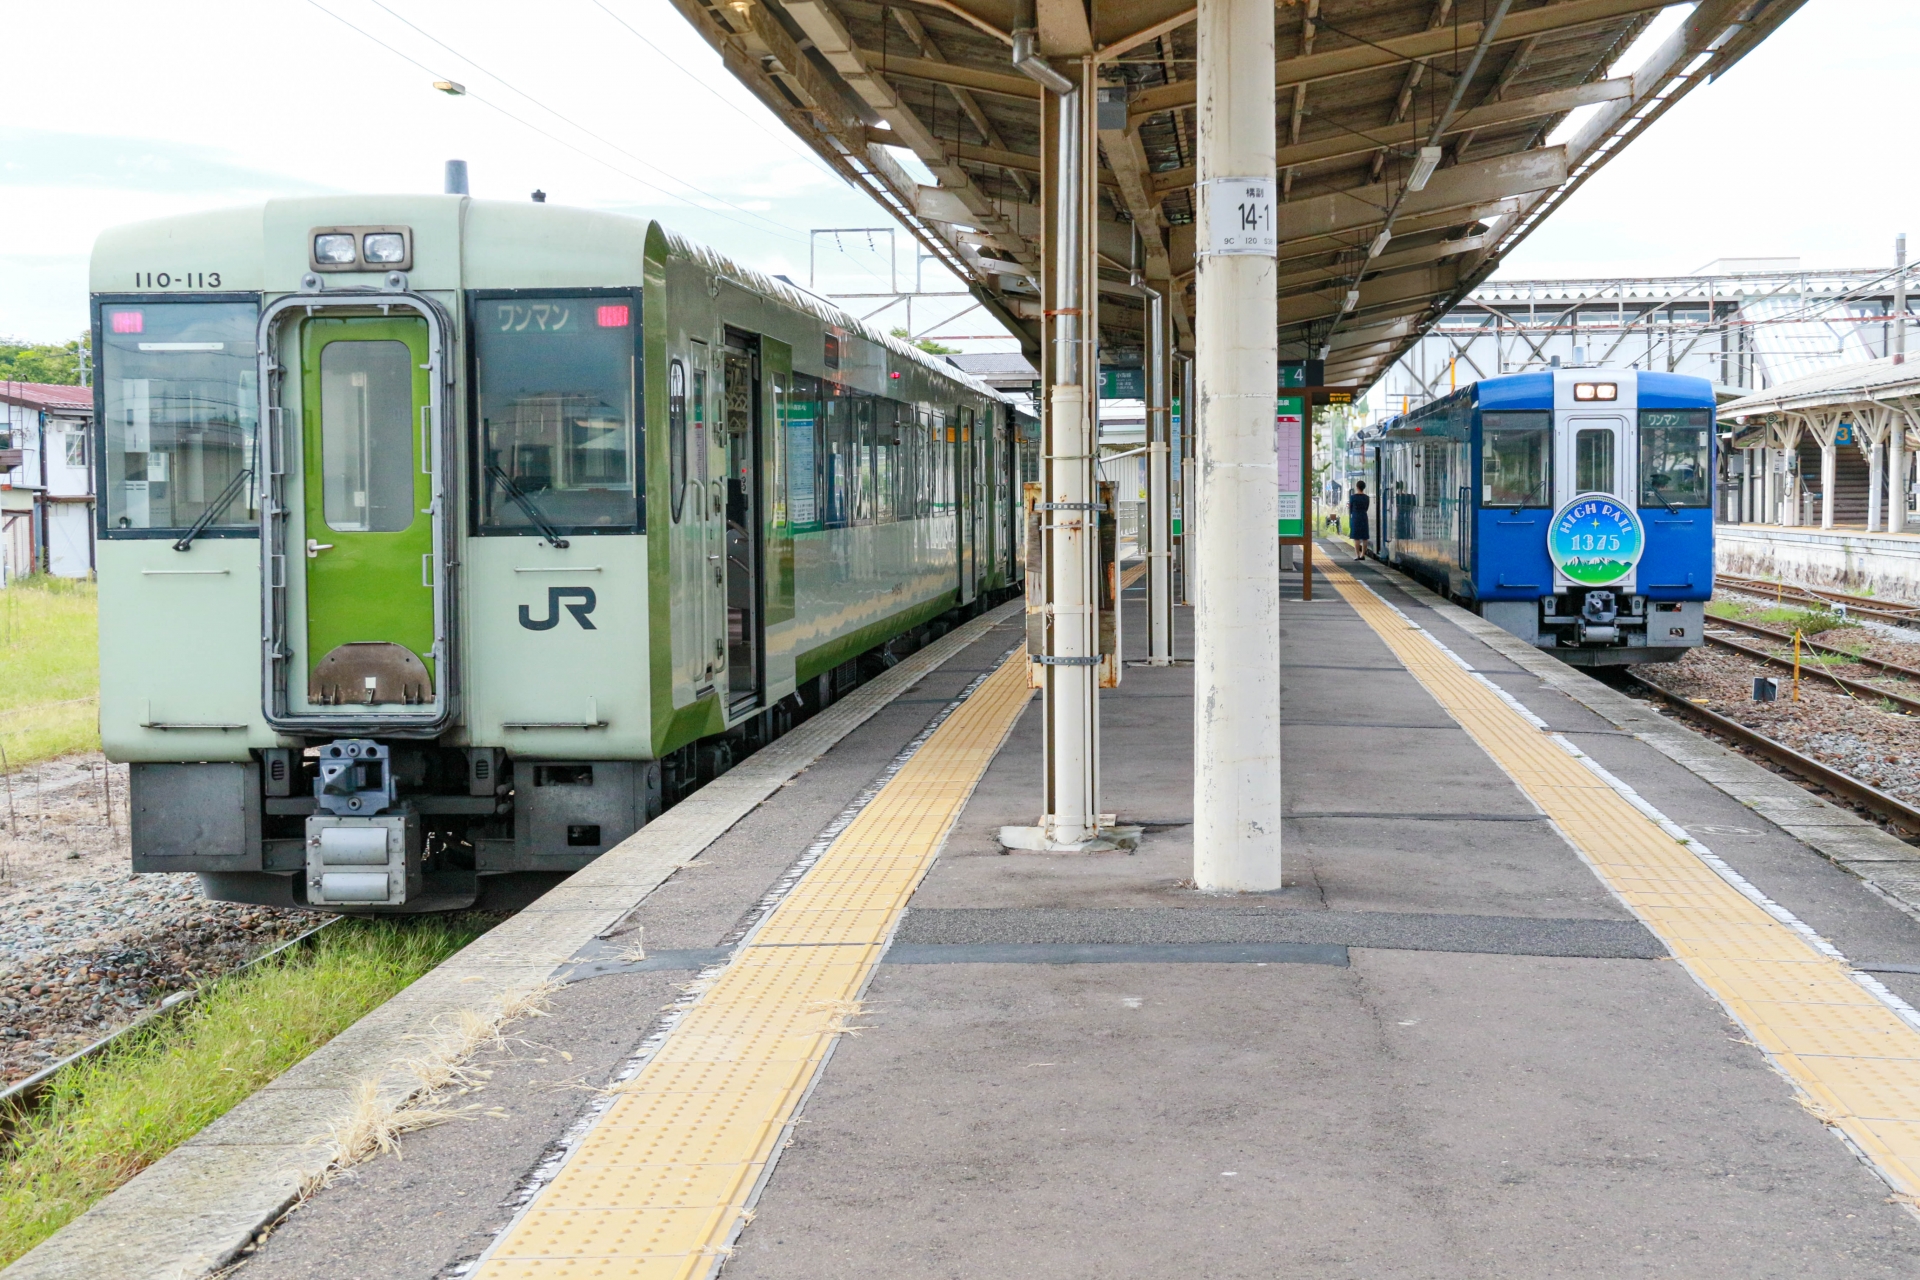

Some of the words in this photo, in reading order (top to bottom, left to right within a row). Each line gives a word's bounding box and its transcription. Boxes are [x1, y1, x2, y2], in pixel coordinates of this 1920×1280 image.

[1238, 203, 1270, 231] 14-1
[136, 272, 222, 288] 110-113
[498, 304, 569, 331] ワンマン
[1099, 372, 1107, 386] 5
[1293, 368, 1304, 381] 4
[1648, 414, 1680, 426] ワンマン
[1836, 427, 1849, 441] 3
[1560, 503, 1597, 534] HIGH
[1601, 504, 1632, 536] RAIL
[1571, 534, 1620, 551] 1375
[518, 586, 597, 631] JR
